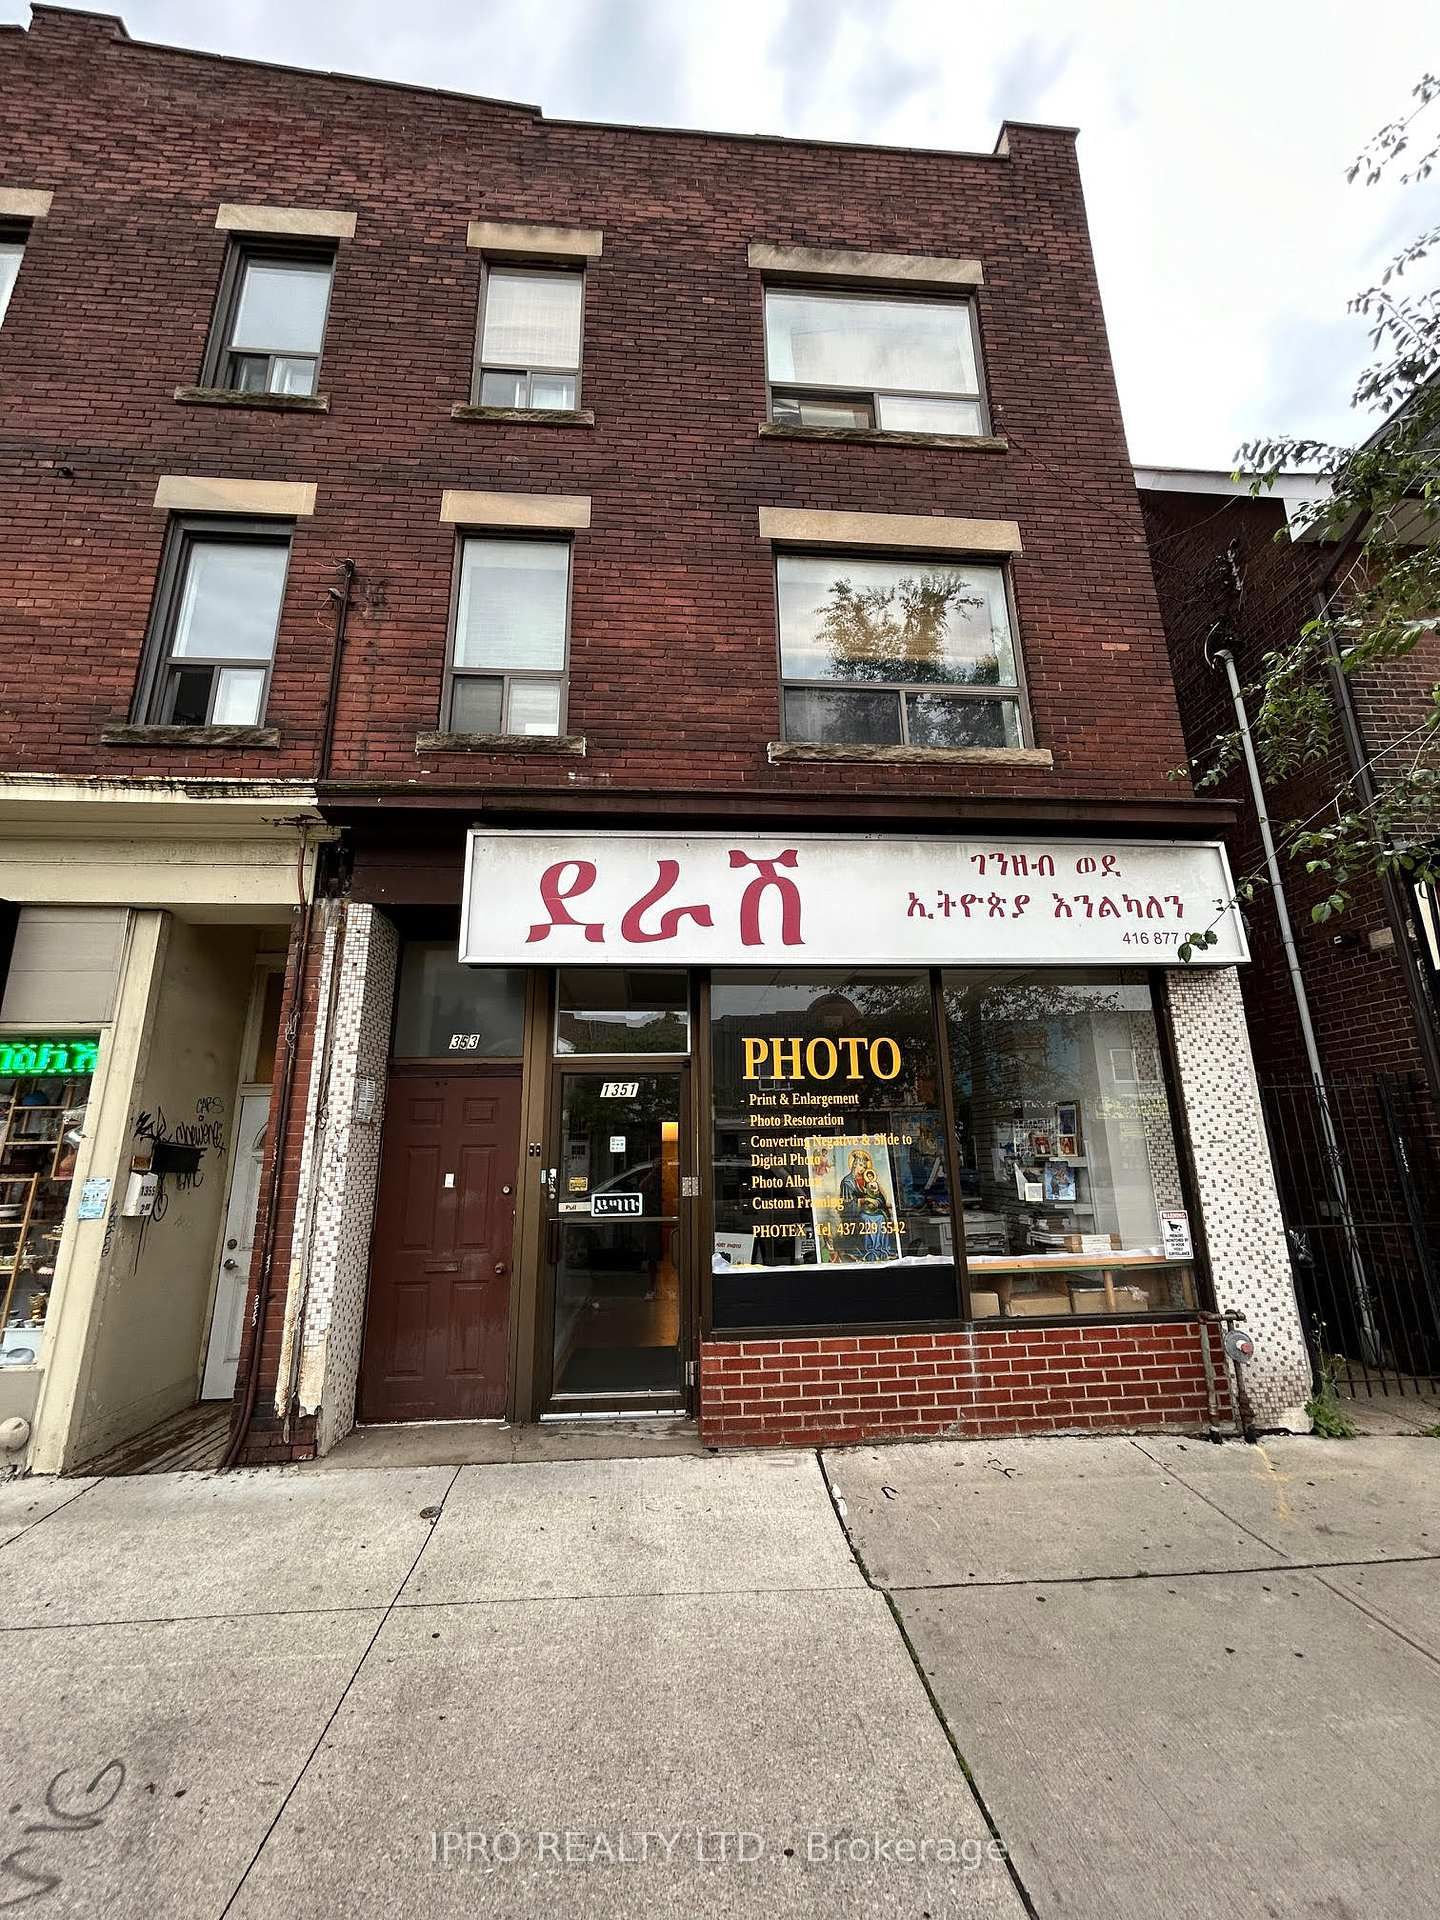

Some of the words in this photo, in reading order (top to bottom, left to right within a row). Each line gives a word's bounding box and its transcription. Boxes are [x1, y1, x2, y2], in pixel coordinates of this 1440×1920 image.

[970, 853, 1055, 877] ገንዘብ
[1076, 855, 1121, 877] ወደ
[525, 849, 806, 947] ደራሽ
[907, 890, 1030, 919] ኢትዮጵያ
[1052, 892, 1184, 918] እንልካለን
[1122, 932, 1149, 944] 416
[1153, 932, 1178, 944] 877
[451, 1035, 478, 1048] 353
[741, 1037, 902, 1080] PHOTO
[603, 1083, 637, 1097] 1351
[749, 1093, 777, 1106] Print
[780, 1093, 789, 1106] &
[792, 1092, 859, 1107] Enlargement
[750, 1114, 781, 1127] Photo
[783, 1113, 845, 1126] Restoration
[750, 1134, 809, 1149] Converting
[813, 1134, 858, 1149] Negative
[861, 1133, 870, 1146] &
[874, 1133, 899, 1146] Slide
[902, 1134, 912, 1146] to
[751, 1153, 787, 1169] Digital
[790, 1153, 821, 1166] Photo
[752, 1175, 783, 1188] Photo
[752, 1197, 794, 1210] Custom
[836, 1222, 856, 1236] 437
